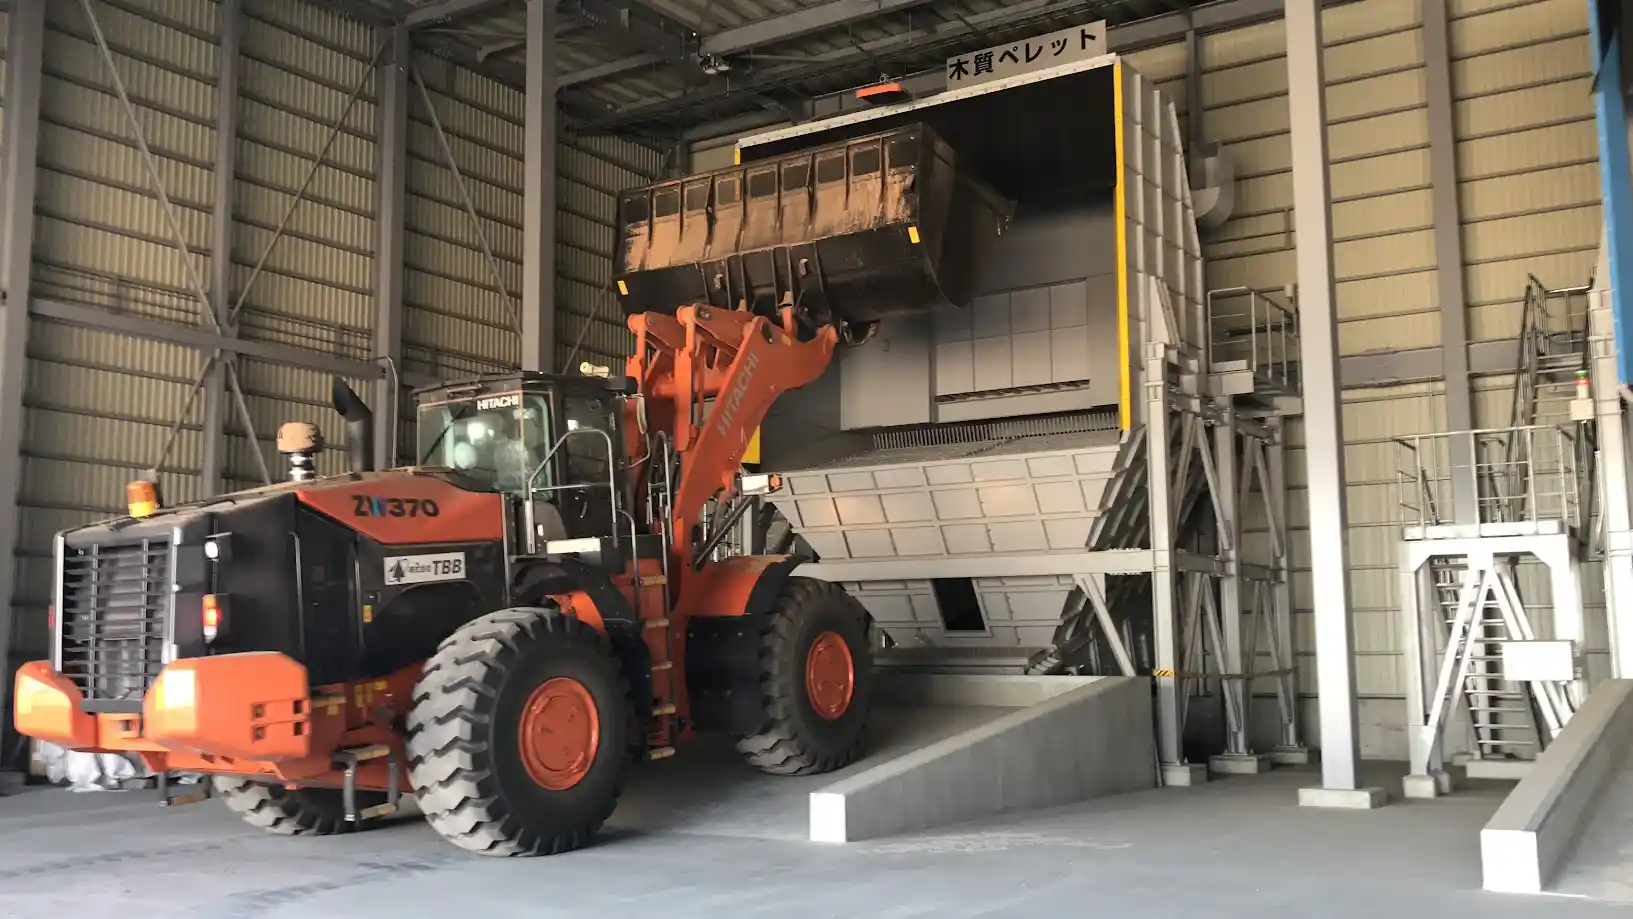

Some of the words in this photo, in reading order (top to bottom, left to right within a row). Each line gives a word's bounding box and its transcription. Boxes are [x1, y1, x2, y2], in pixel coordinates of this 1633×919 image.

[949, 28, 1096, 80] 木質ペレット
[477, 395, 519, 410] HITACHI
[716, 350, 758, 438] HITACHI
[352, 494, 440, 517] ZW370
[432, 559, 462, 576] TBB
